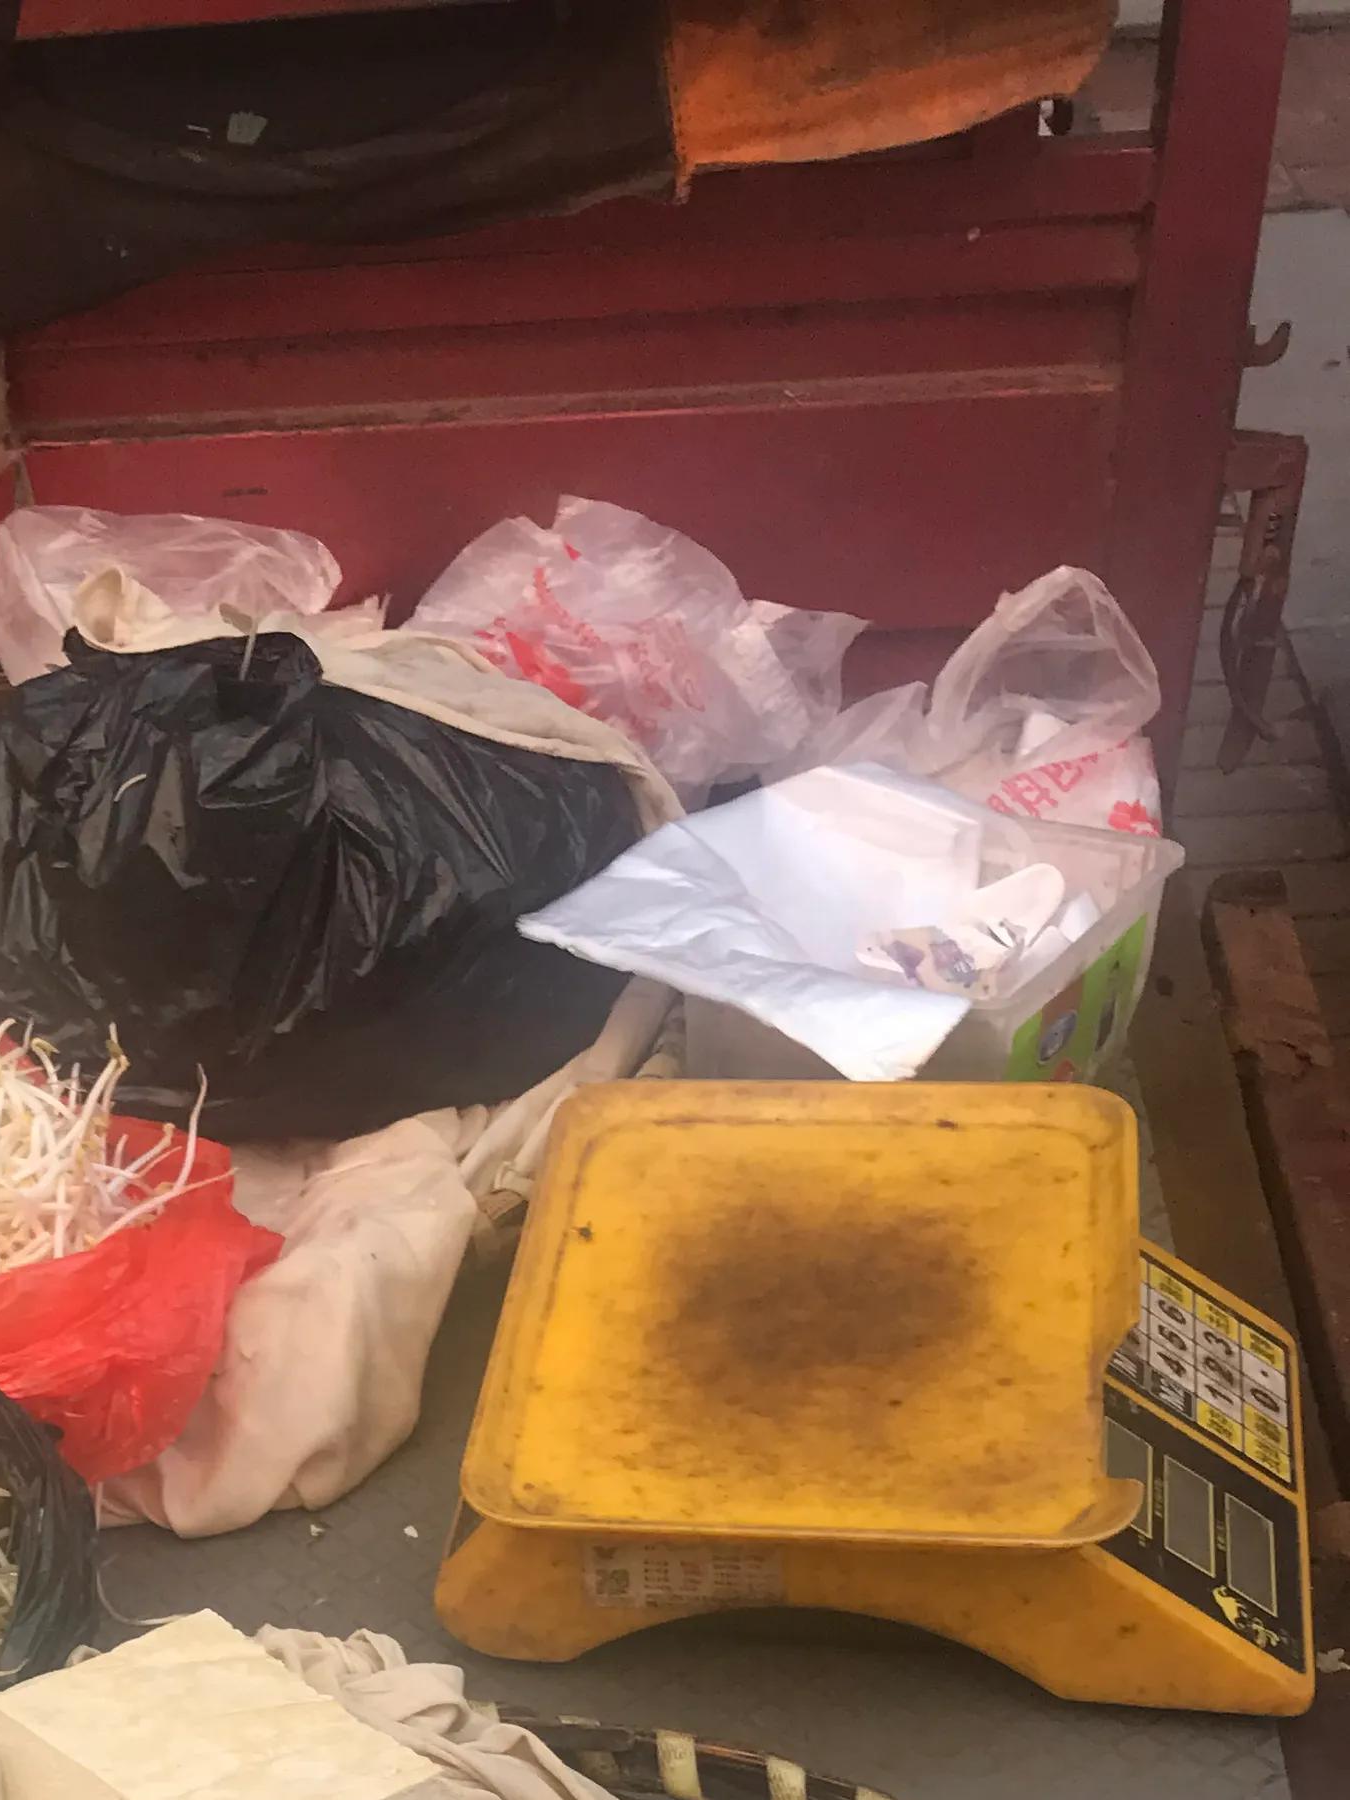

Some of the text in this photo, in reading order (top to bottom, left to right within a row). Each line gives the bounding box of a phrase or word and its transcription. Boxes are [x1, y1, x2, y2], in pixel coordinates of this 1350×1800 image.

[1158, 1299, 1187, 1325] 6
[1157, 1324, 1187, 1351] 5
[1203, 1331, 1232, 1356] 3
[1156, 1351, 1187, 1378] 4
[1202, 1357, 1234, 1386] 2
[1205, 1383, 1234, 1406] 1
[1250, 1388, 1280, 1413] 0
